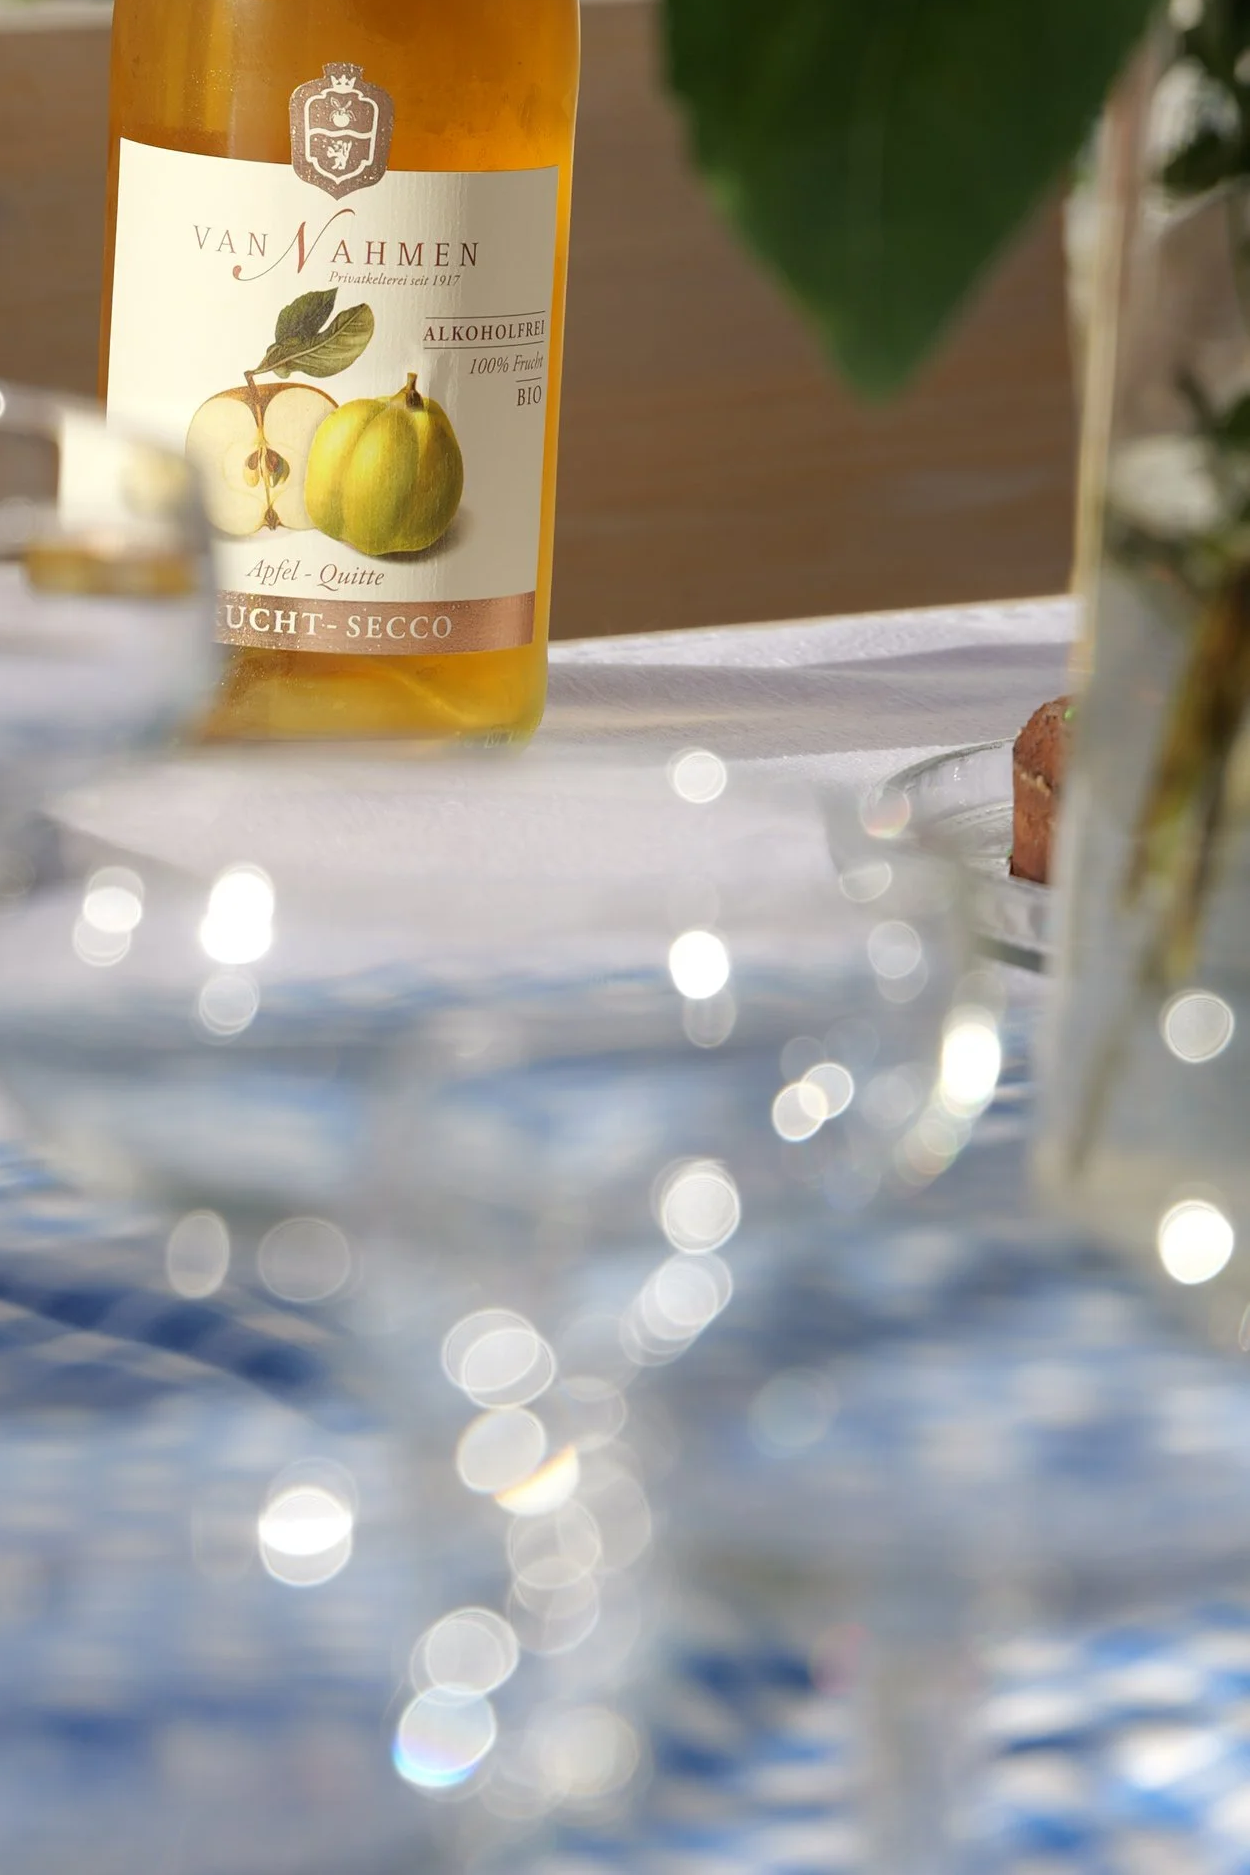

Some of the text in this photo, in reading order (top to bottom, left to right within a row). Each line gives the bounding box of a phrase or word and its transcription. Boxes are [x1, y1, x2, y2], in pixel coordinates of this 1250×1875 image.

[193, 208, 479, 281] VAN NAHMEN
[328, 271, 461, 287] Privatkelterei seit 1917
[423, 319, 545, 342] ALKOHOLFREI
[469, 351, 544, 375] 100% Frucht
[516, 385, 543, 406] BIO
[246, 558, 301, 586] Apfel
[316, 563, 385, 592] Quitte
